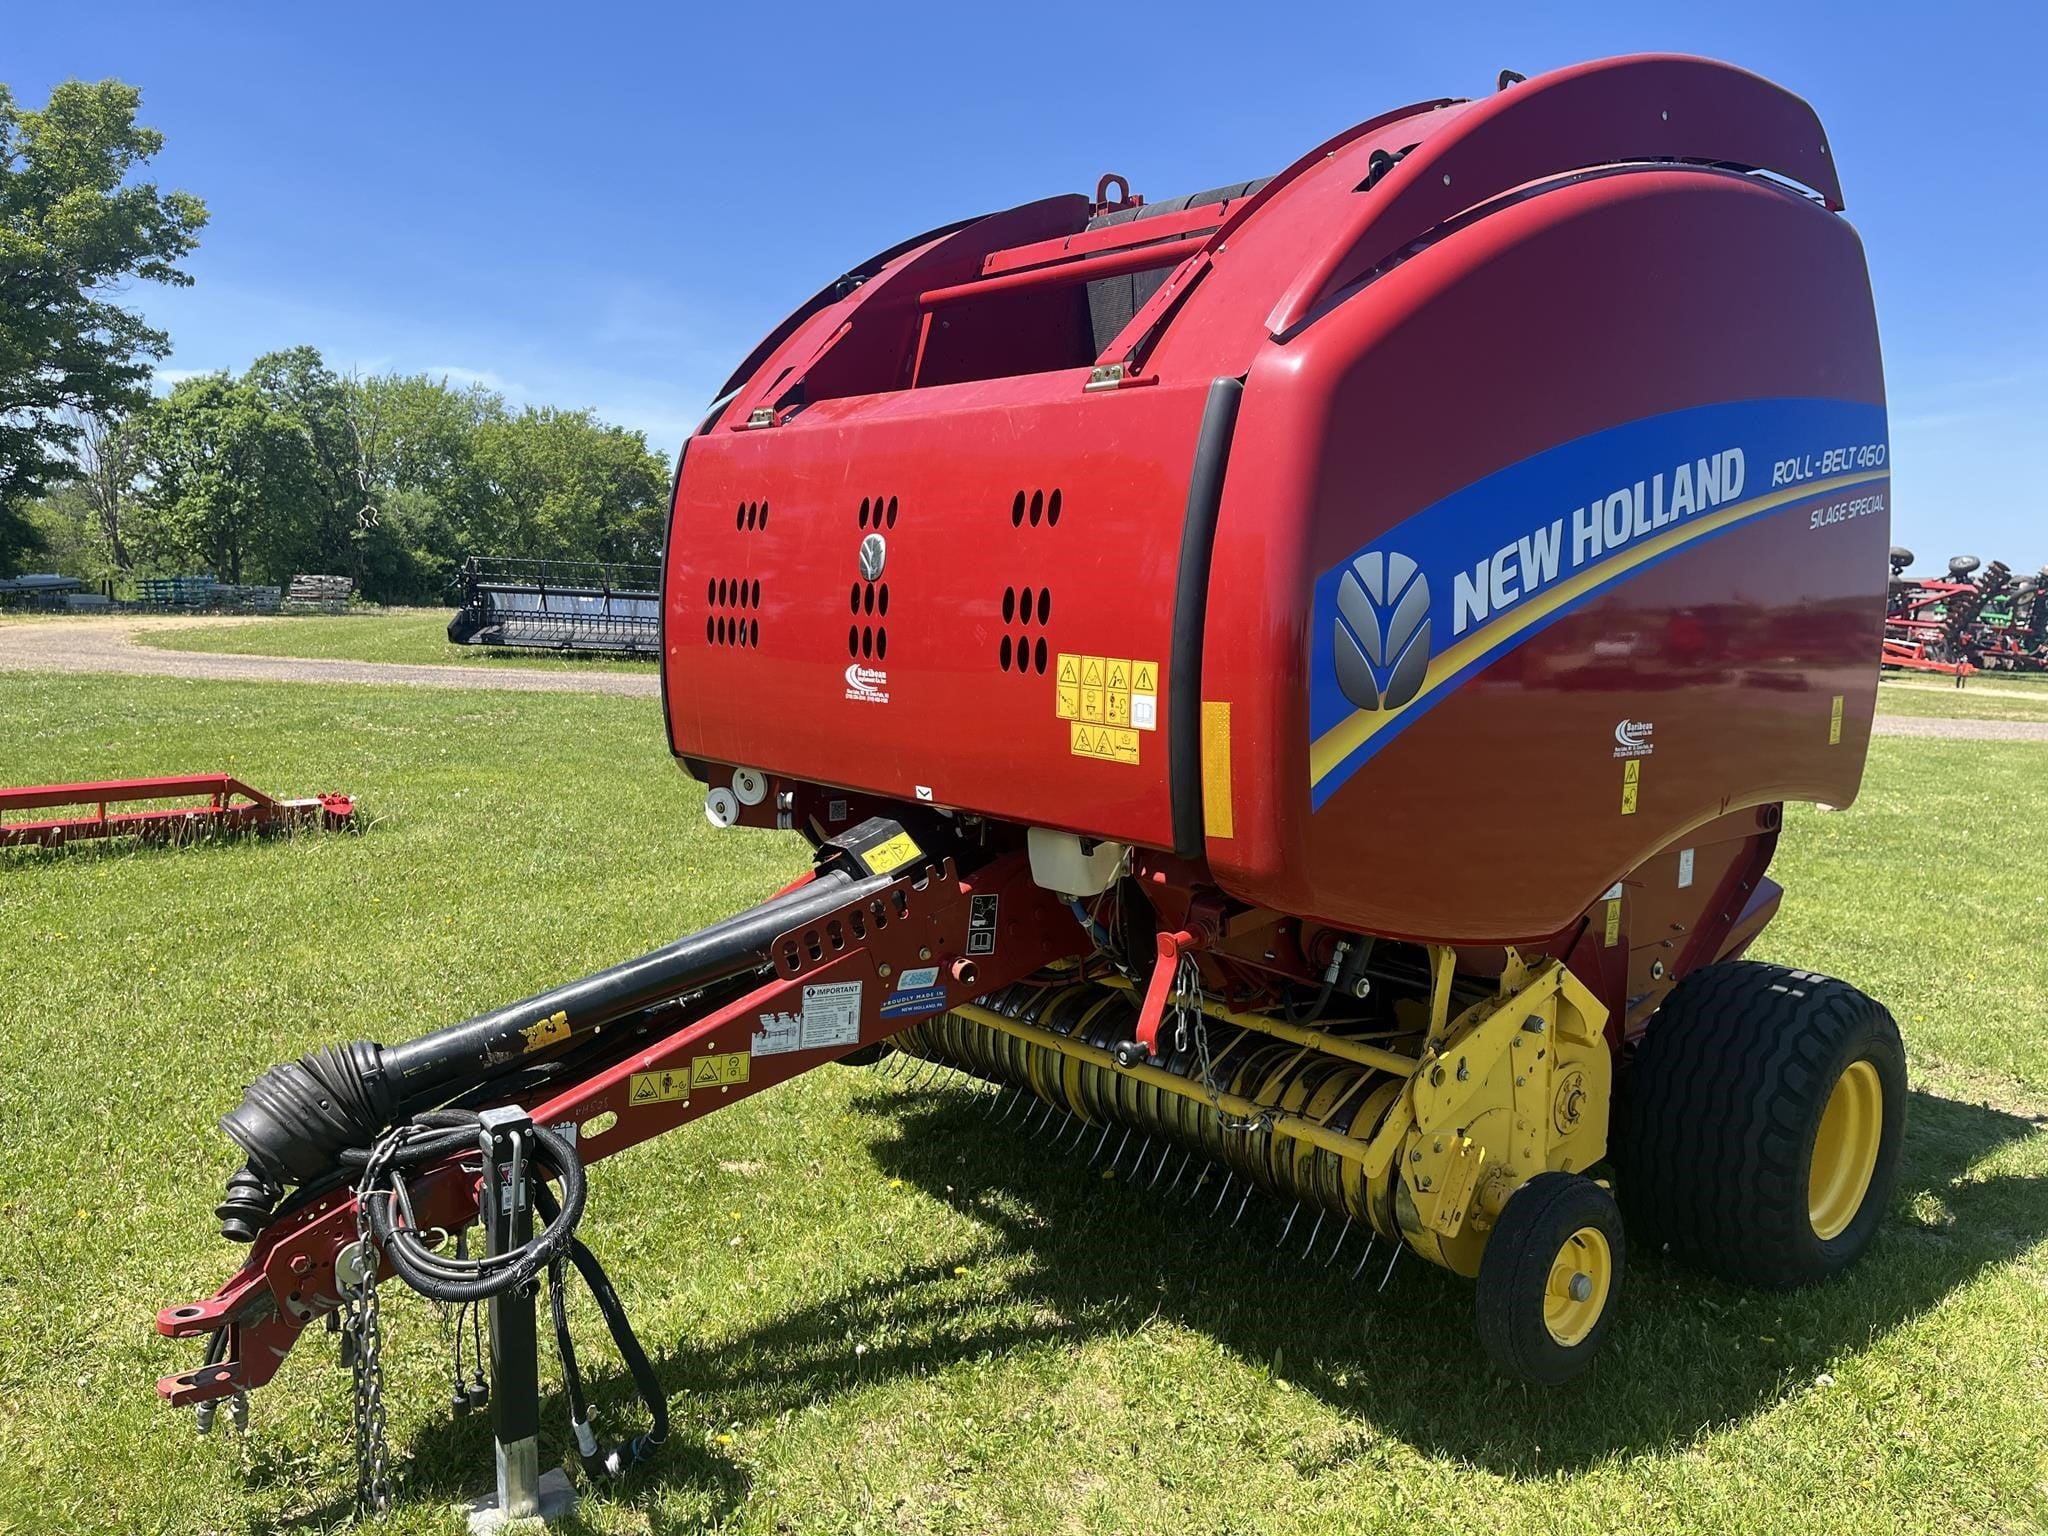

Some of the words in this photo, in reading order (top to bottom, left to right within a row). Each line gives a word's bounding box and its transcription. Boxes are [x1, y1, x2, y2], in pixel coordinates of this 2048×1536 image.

[1857, 443, 1886, 468] 460
[1809, 502, 1847, 530] SILAGE
[1848, 494, 1885, 519] SPECIAL
[1453, 517, 1563, 636] NEW
[1572, 447, 1745, 567] HOLLAND
[816, 985, 858, 996] IMPORTANT
